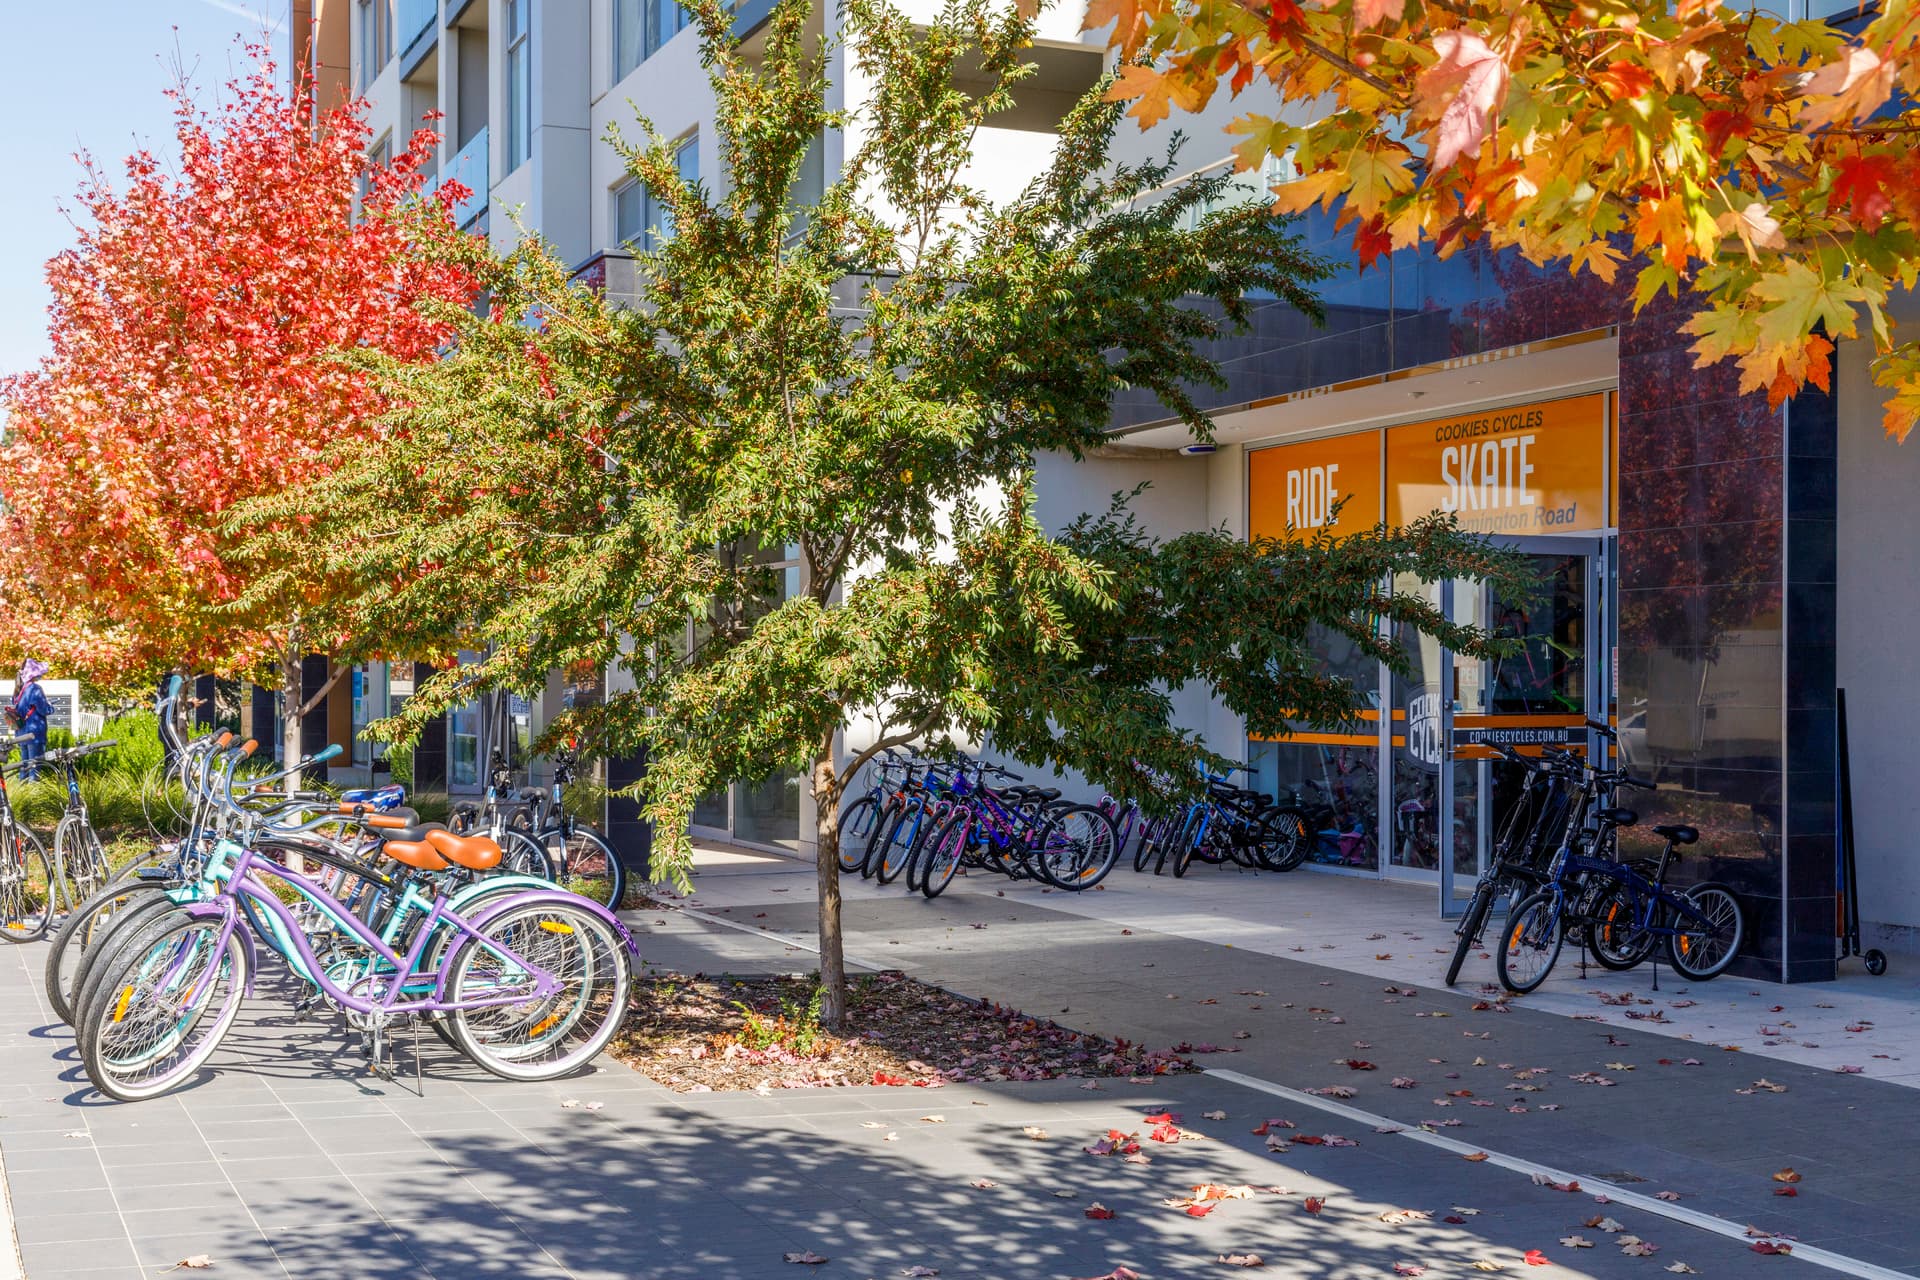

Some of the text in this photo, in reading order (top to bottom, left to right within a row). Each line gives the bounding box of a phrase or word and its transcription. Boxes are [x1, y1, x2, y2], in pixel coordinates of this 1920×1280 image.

[1435, 410, 1544, 442] COOKIES CYCLES
[1442, 435, 1536, 512] SKATE
[1287, 463, 1339, 529] RIDE
[1458, 502, 1577, 532] emington Road
[1409, 692, 1441, 725] COOK
[1409, 717, 1441, 765] CYCL
[1469, 729, 1569, 744] COOKIESCYCLES.COM.AU
